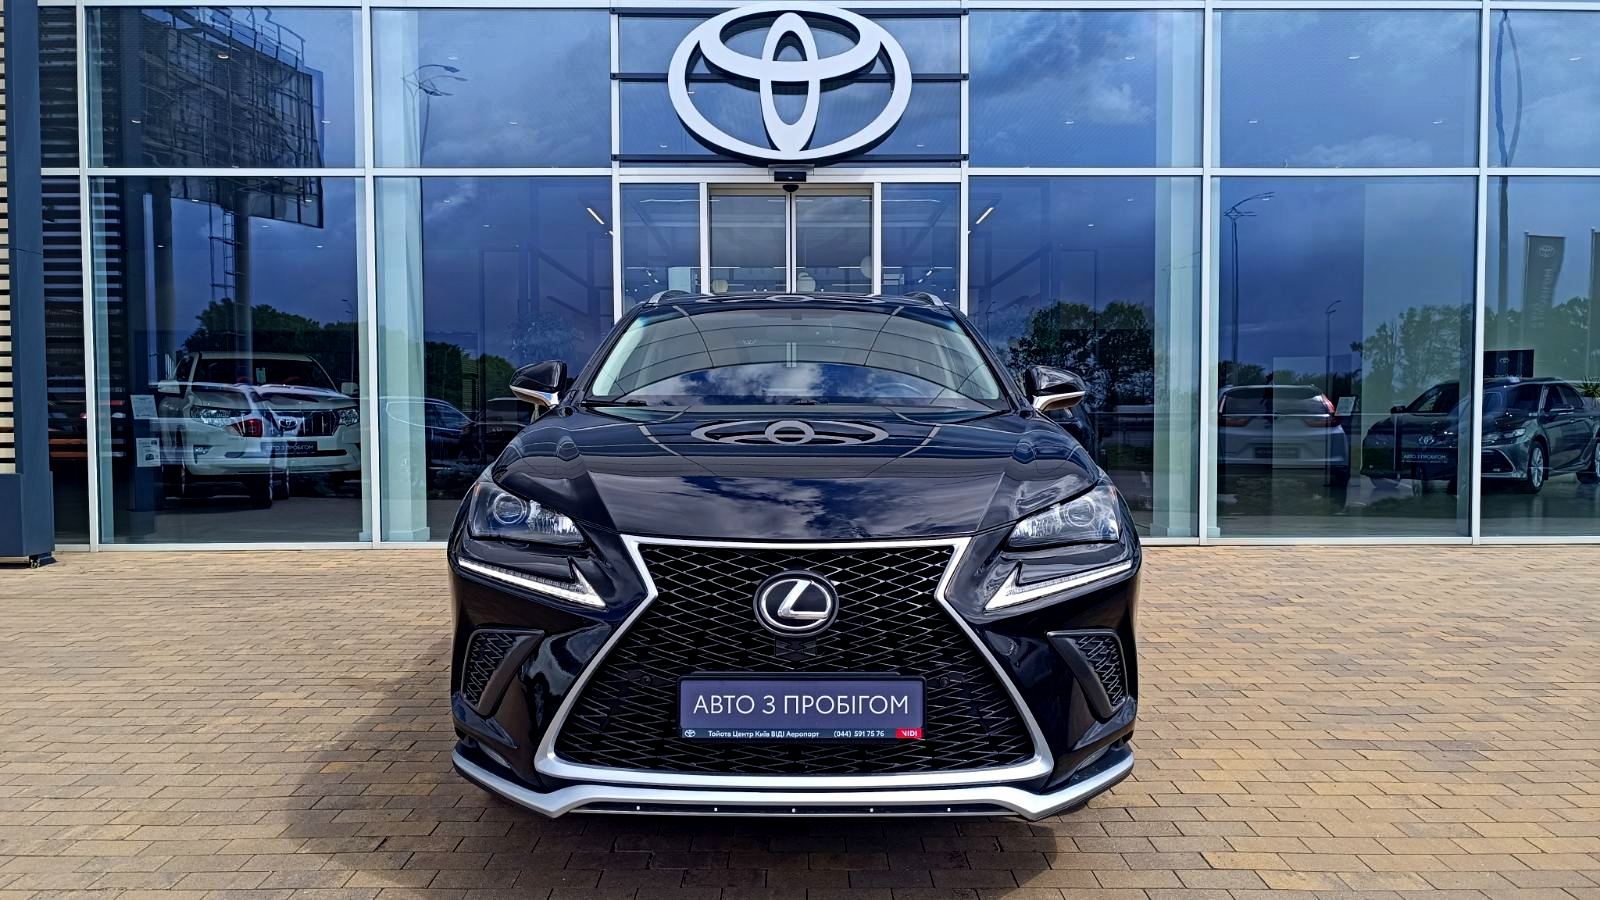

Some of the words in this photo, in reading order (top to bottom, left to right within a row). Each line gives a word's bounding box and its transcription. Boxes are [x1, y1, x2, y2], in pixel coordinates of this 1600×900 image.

[693, 695, 755, 715] АВТО
[784, 695, 909, 715] ПРОБІГОМ
[708, 730, 731, 738] Тойота
[732, 730, 754, 739] Центр
[755, 730, 770, 738] Київ
[786, 730, 820, 739] Аеропорт
[833, 730, 852, 739] (044)
[854, 730, 865, 738] 591
[867, 730, 875, 738] 75
[876, 730, 885, 738] 76
[901, 730, 918, 738] VIDI
